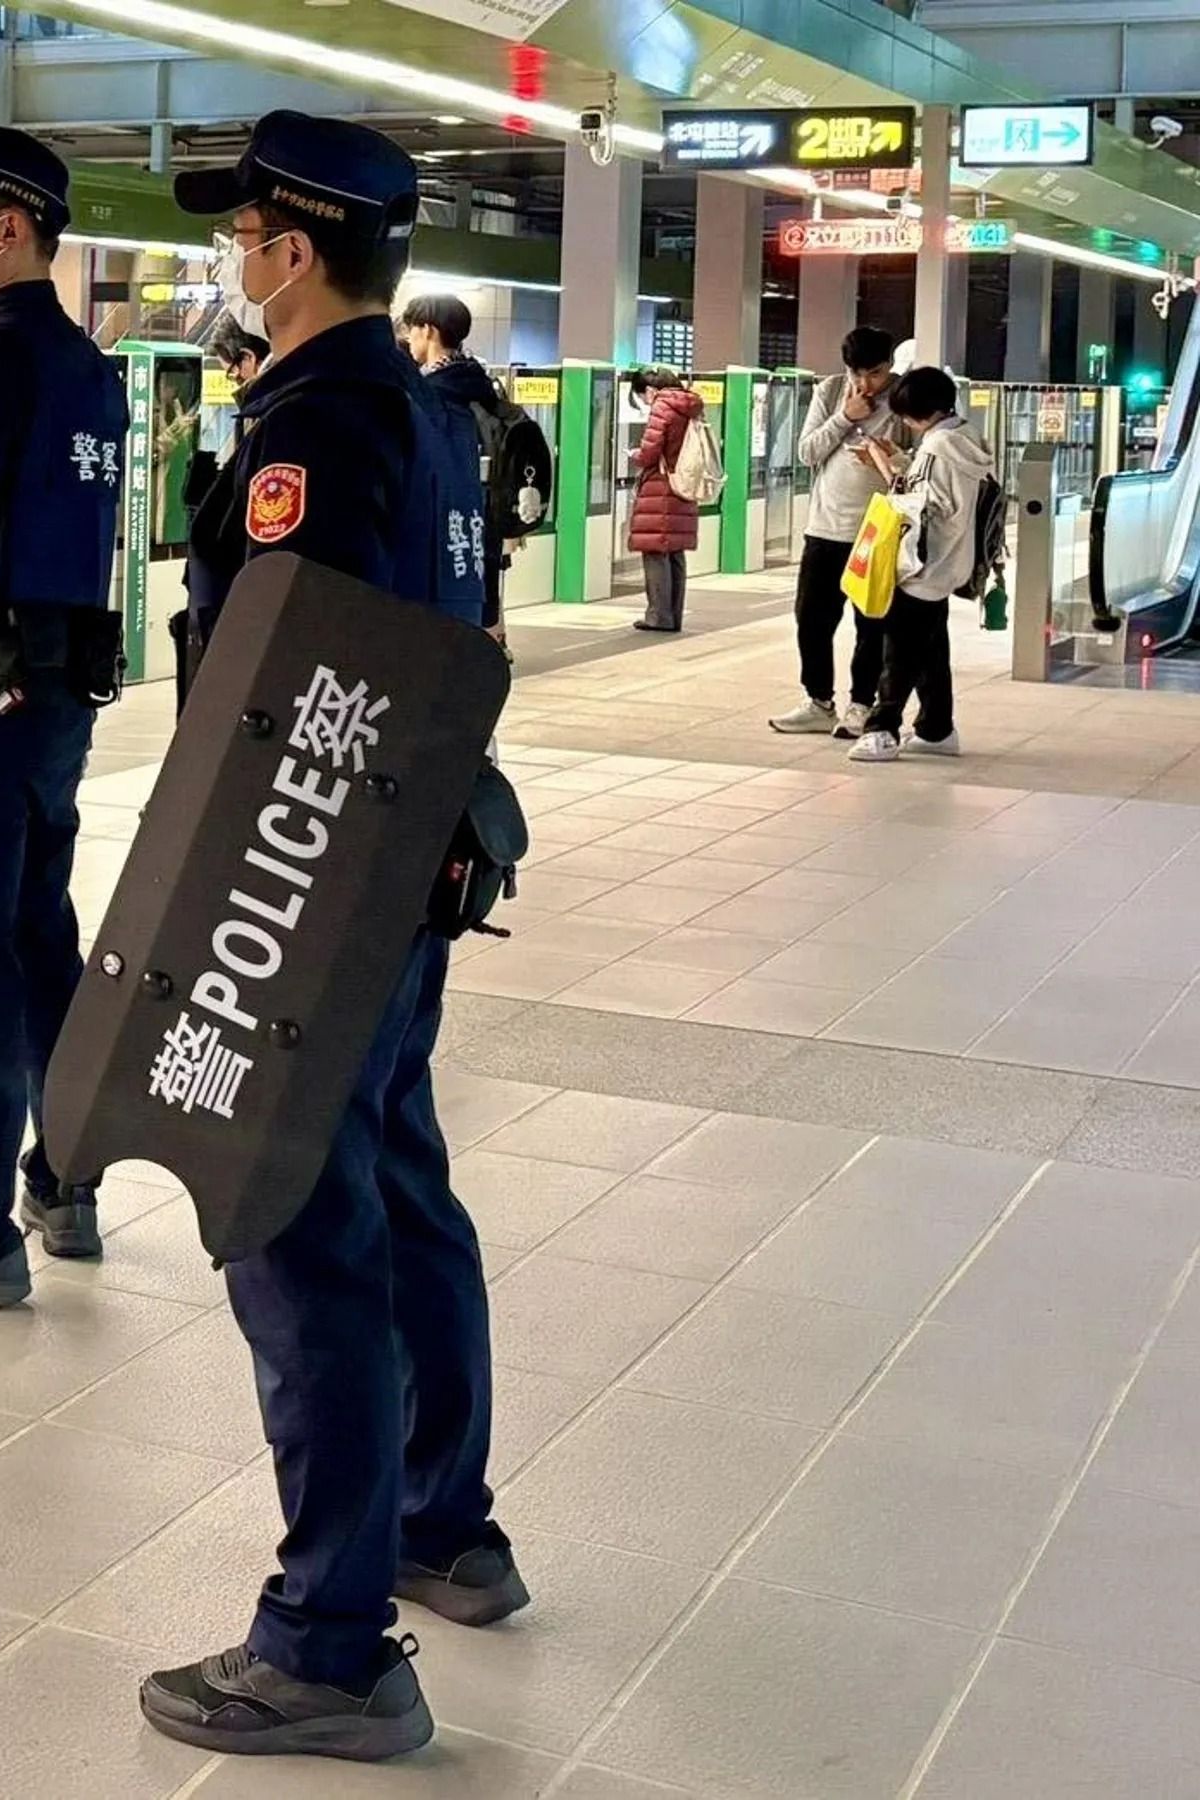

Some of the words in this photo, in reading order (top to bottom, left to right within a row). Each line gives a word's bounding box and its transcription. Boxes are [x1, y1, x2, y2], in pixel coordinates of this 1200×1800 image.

[798, 118, 828, 159] 2
[828, 117, 871, 141] 出口
[190, 755, 351, 1032] POLICE
